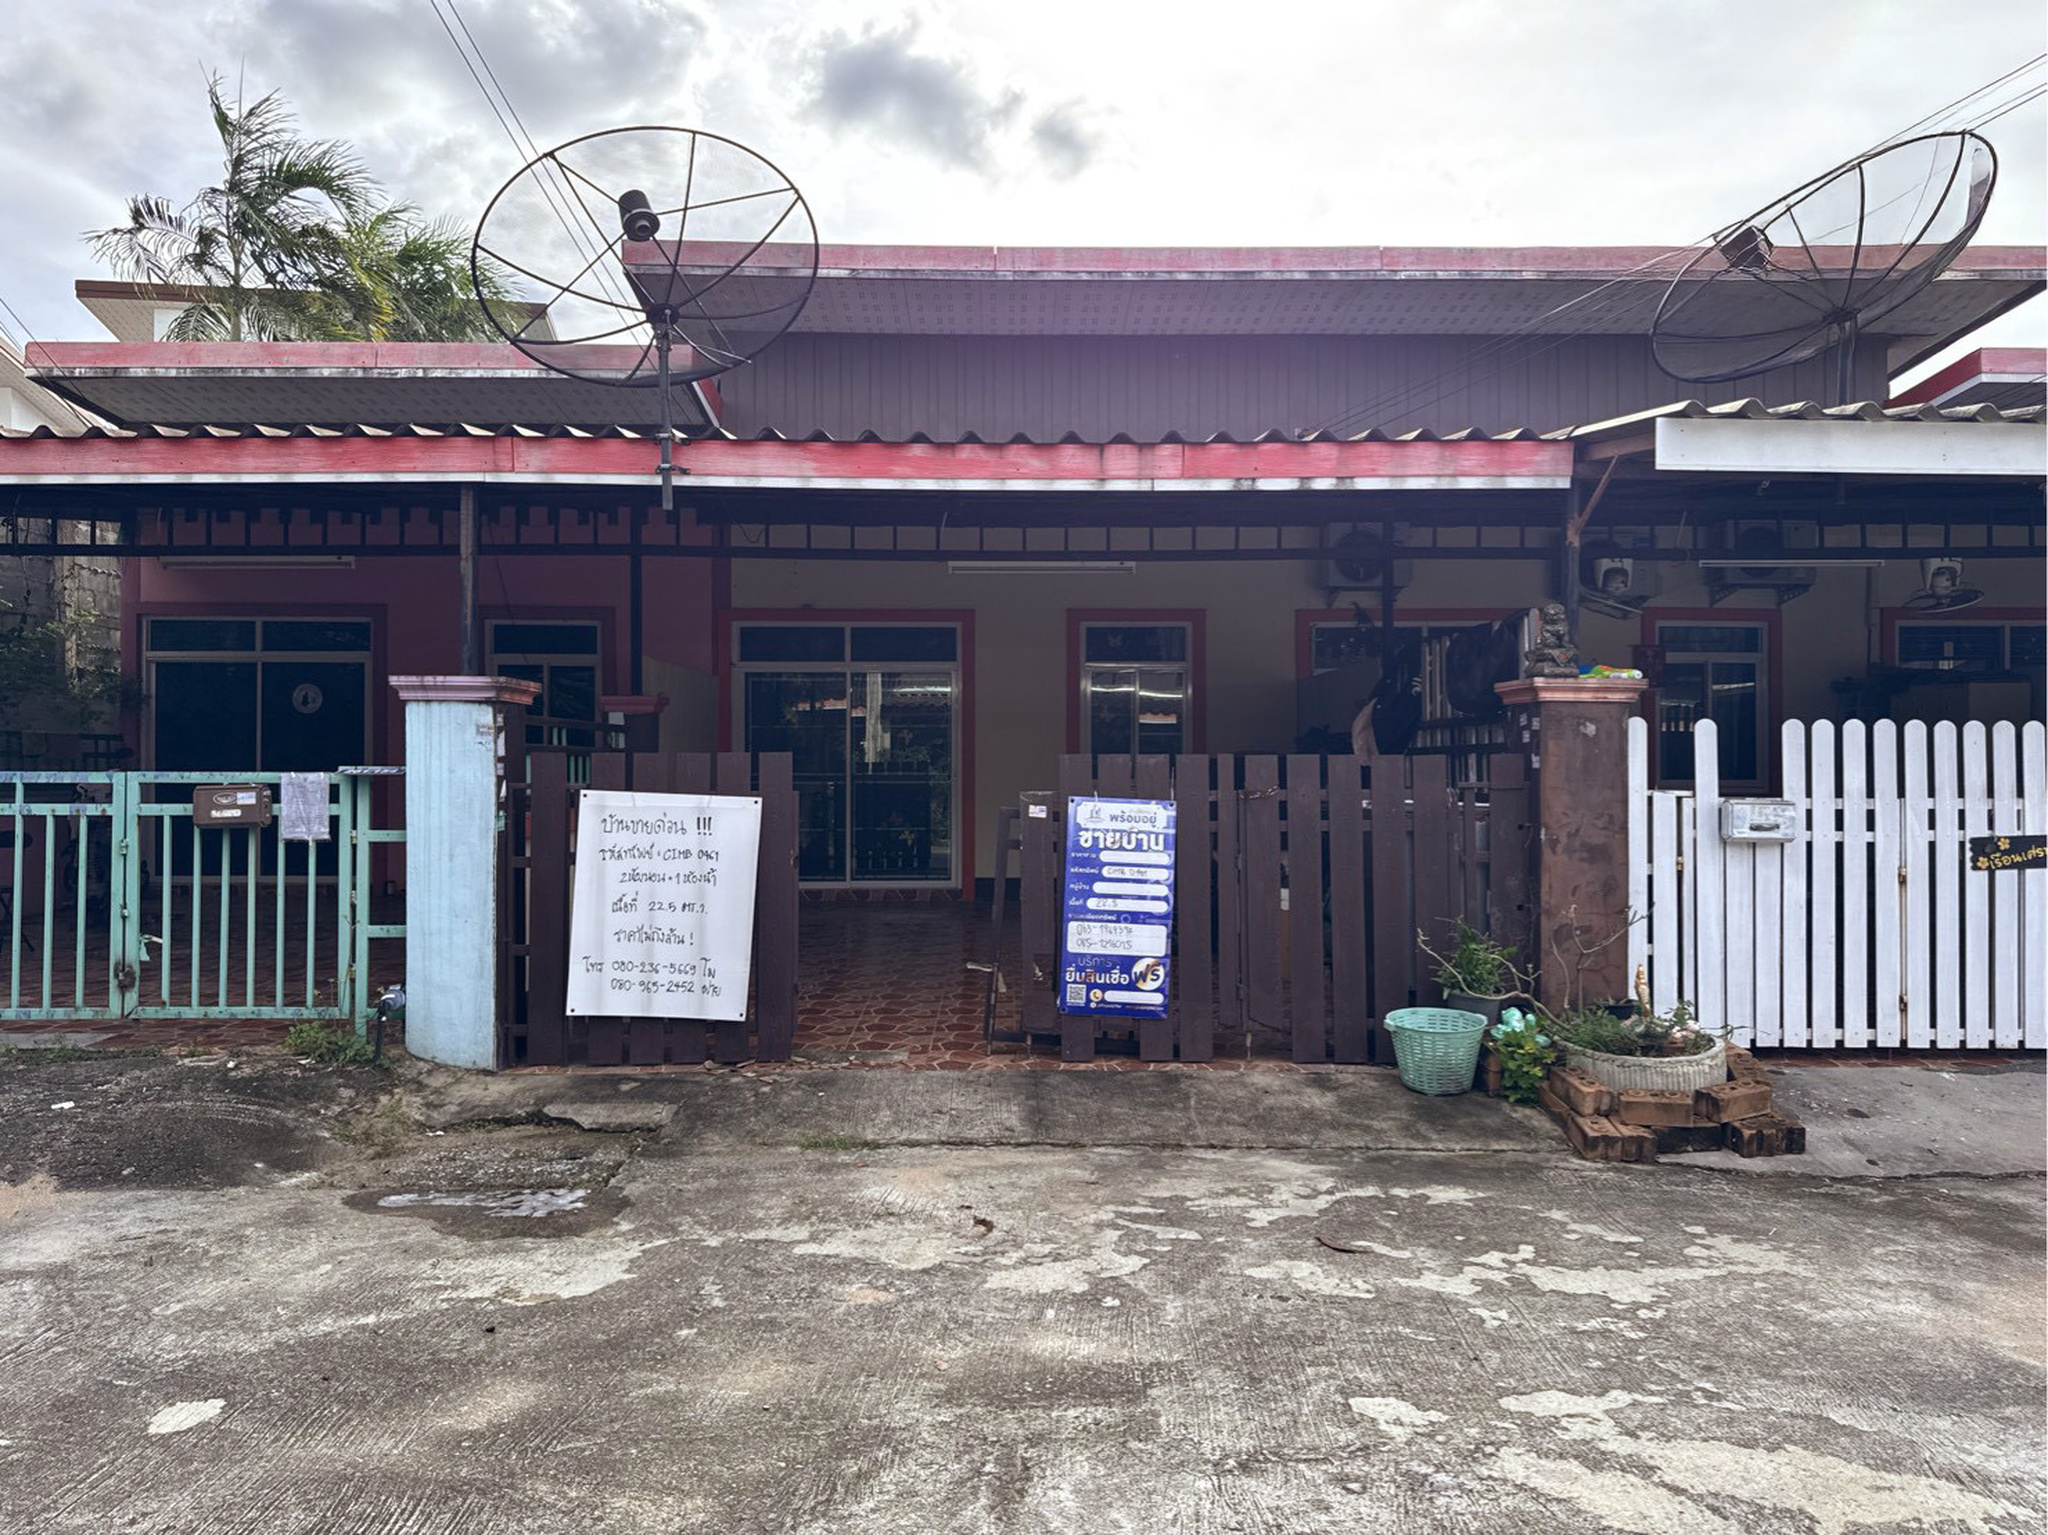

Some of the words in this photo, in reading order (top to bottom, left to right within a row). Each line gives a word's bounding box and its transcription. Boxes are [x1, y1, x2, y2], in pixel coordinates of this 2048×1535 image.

[601, 812, 688, 835] บ้านขายด่วน
[697, 816, 712, 836] !!!
[1109, 810, 1157, 828] พร้อมอยู่
[1078, 826, 1164, 851] ขายบ้าน
[663, 849, 693, 861] CIMB
[648, 900, 677, 912] 22.5
